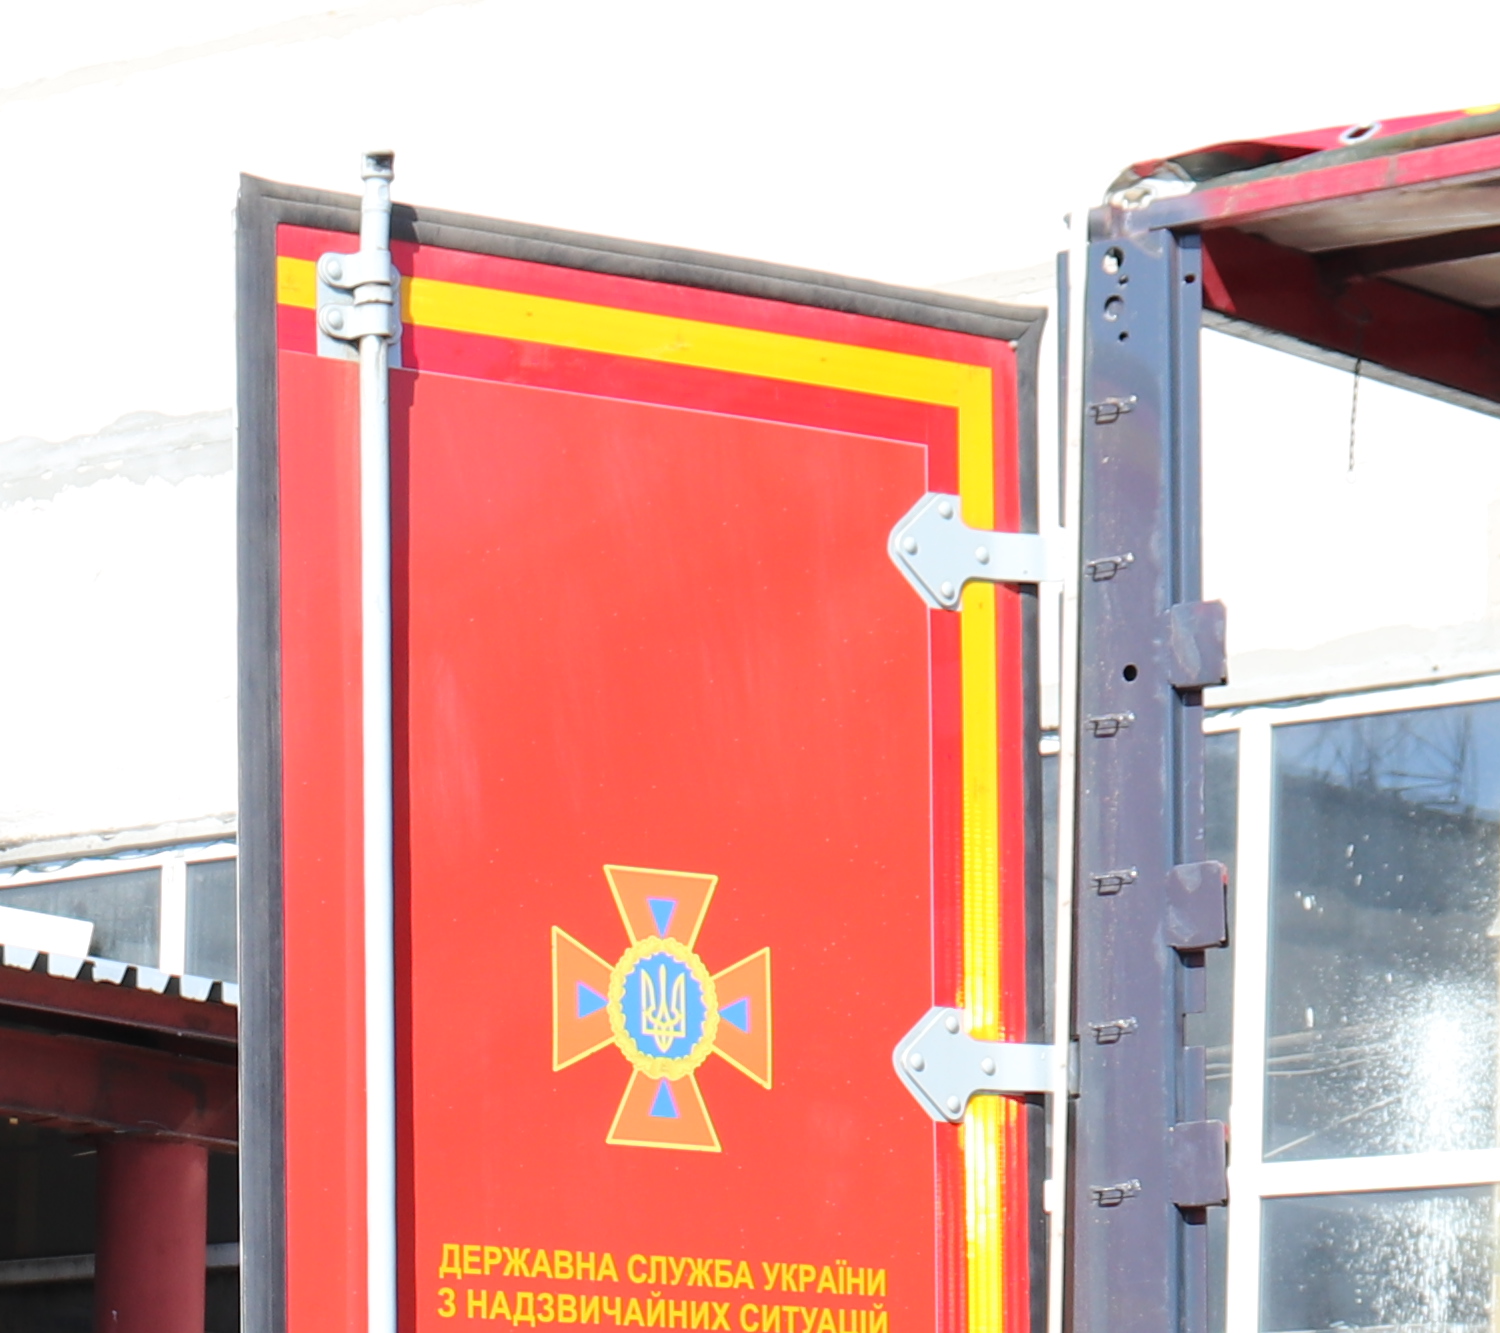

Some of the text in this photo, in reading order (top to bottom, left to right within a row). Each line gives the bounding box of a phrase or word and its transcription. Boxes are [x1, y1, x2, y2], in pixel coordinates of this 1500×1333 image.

[438, 1242, 888, 1297] ДЕРЖАВНА СЛУЖБА УКРАЇНИ
[437, 1286, 457, 1318] З
[466, 1289, 732, 1332] НАДЗВИЧАЙНИХ
